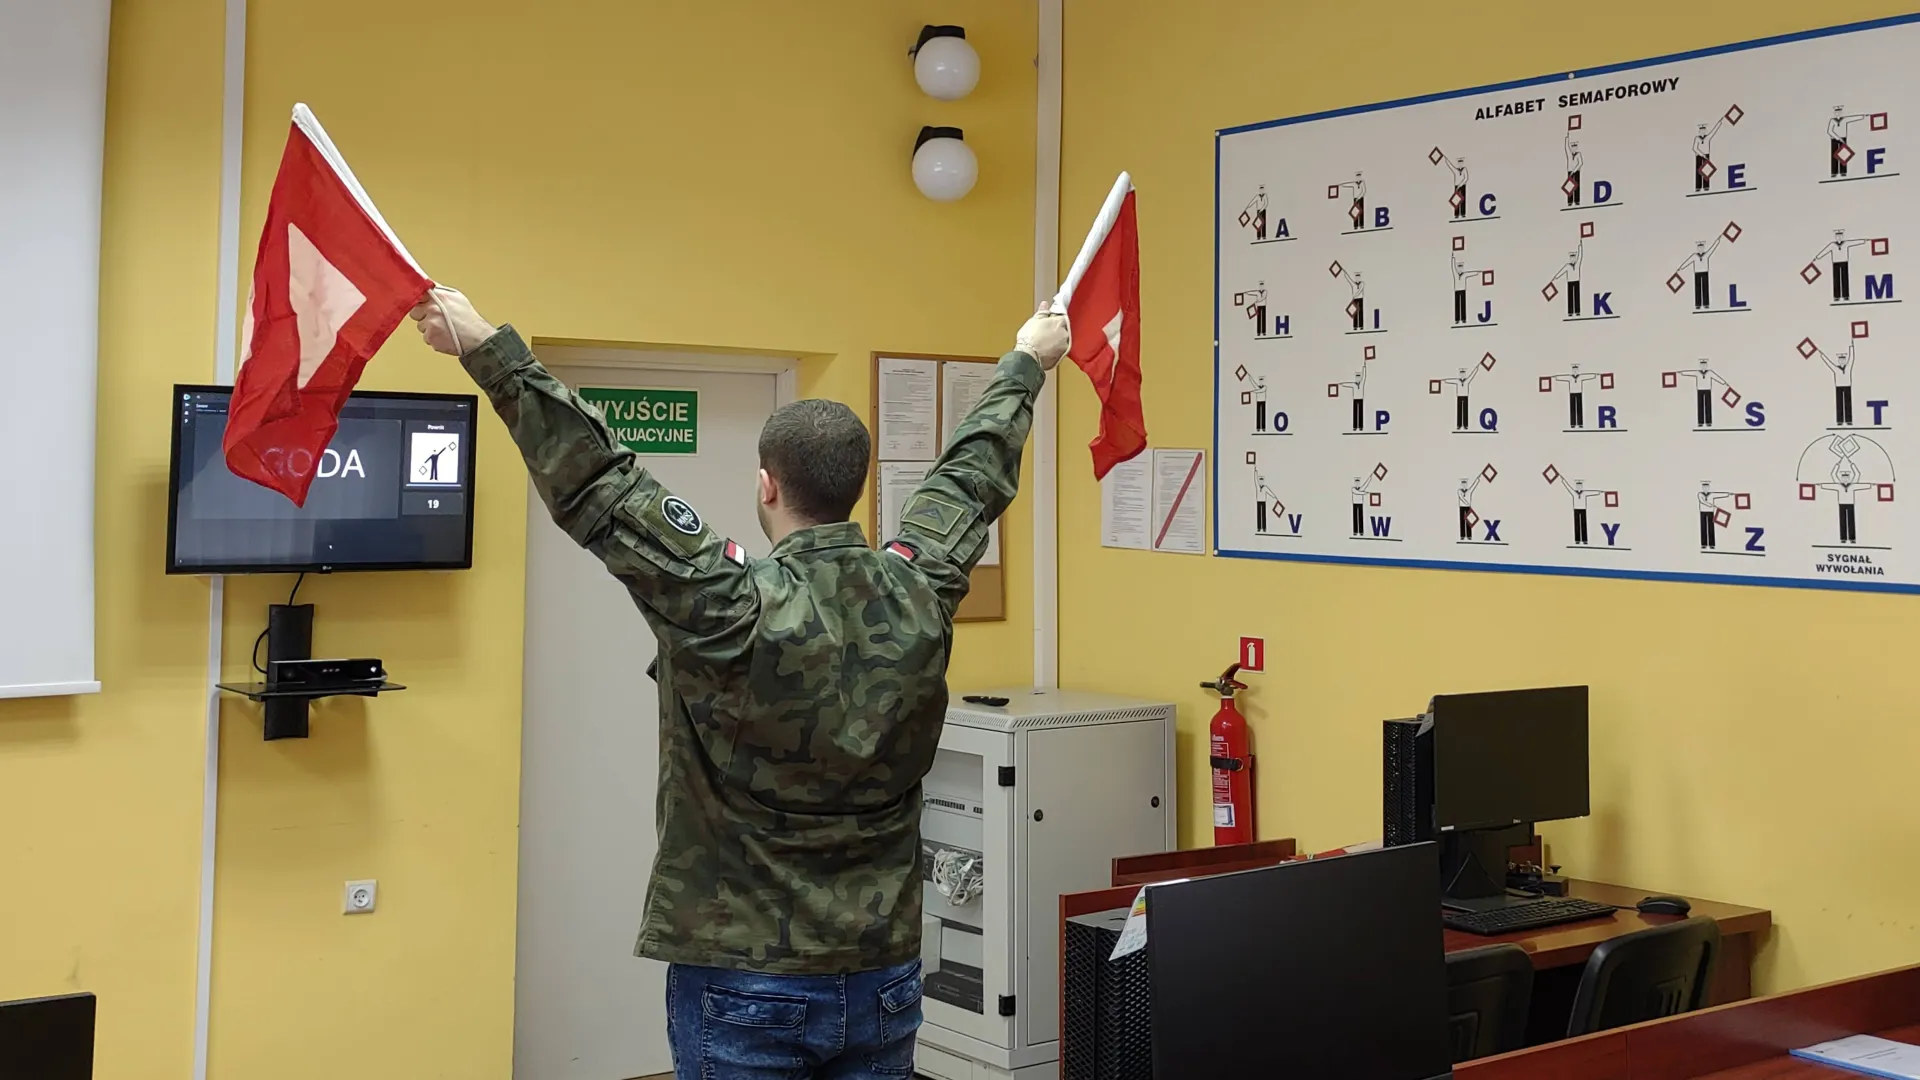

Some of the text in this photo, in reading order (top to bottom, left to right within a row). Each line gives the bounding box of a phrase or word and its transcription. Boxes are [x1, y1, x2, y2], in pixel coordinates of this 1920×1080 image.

[1475, 77, 1680, 120] ALFABET SEMAFOROWY
[1866, 148, 1886, 174] F
[1728, 163, 1746, 189] E
[1593, 180, 1612, 204] D
[1479, 194, 1496, 216] C
[1275, 218, 1290, 238] A
[1374, 207, 1390, 228] B
[1729, 284, 1747, 308] L
[1865, 274, 1893, 300] M
[1477, 301, 1491, 323] J
[1593, 292, 1613, 316] K
[1275, 315, 1290, 335] H
[1374, 309, 1380, 329] I
[588, 397, 689, 421] WYJŚCIE
[1480, 408, 1497, 431] Q
[1598, 406, 1616, 428] R
[1745, 402, 1765, 426] S
[1867, 400, 1888, 425] T
[1376, 411, 1390, 430] P
[610, 428, 693, 442] AKUACYJNE
[428, 499, 440, 509] 19
[1288, 514, 1302, 533] V
[1370, 516, 1391, 537] W
[1484, 520, 1500, 541] X
[1601, 523, 1620, 546] Y
[1745, 527, 1765, 551] Z
[1827, 553, 1872, 564] SYGNAŁ
[1816, 564, 1884, 576] WYWOŁANIA
